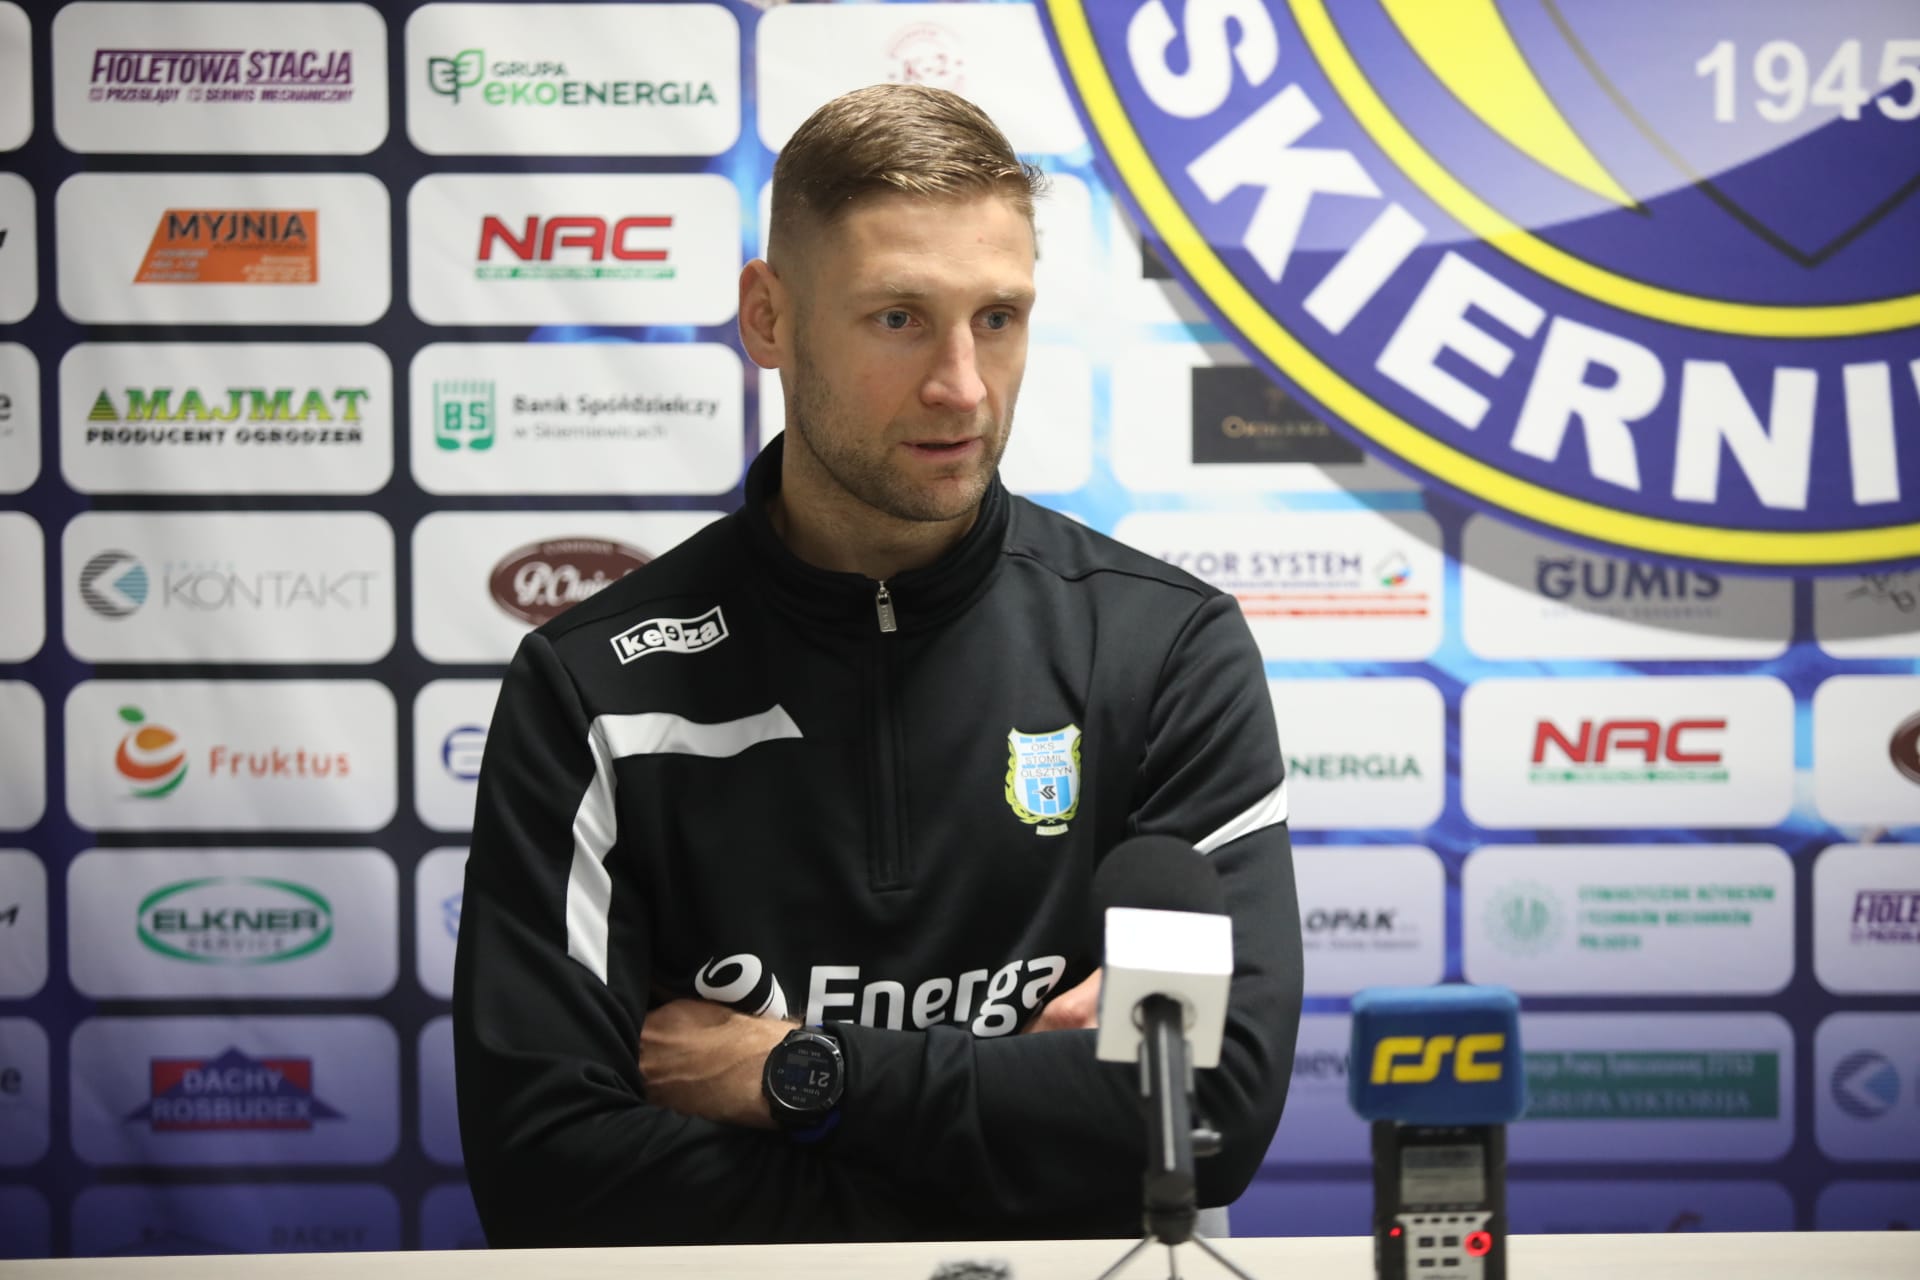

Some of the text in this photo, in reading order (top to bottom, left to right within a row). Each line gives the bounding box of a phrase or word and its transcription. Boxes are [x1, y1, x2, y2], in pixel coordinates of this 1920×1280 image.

[91, 48, 353, 85] FIOLETOWA STACJA
[492, 61, 568, 78] GRUPA
[1696, 39, 1920, 123] 1945
[483, 81, 717, 107] ekoENERGIA
[167, 213, 308, 242] MYJNIA
[477, 215, 674, 262] NAC
[1127, 0, 1920, 513] SKIERNI
[125, 387, 370, 423] MAJMAT
[513, 394, 568, 415] Bank
[86, 427, 225, 446] PRODUCENT
[1251, 551, 1362, 577] SYSTEM
[1536, 556, 1721, 600] GUMIS
[162, 570, 381, 612] KONTAKT
[620, 618, 720, 657] keeza
[1031, 742, 1056, 752] OKS
[1531, 719, 1728, 763] NAC
[209, 745, 351, 779] Fruktus
[1020, 765, 1073, 778] OLSZTYN
[1025, 754, 1064, 766] STOMIL
[1286, 754, 1423, 780] NERGIA
[153, 907, 319, 933] ELKNER
[805, 954, 1067, 1038] Energa
[182, 1067, 284, 1094] DACHY
